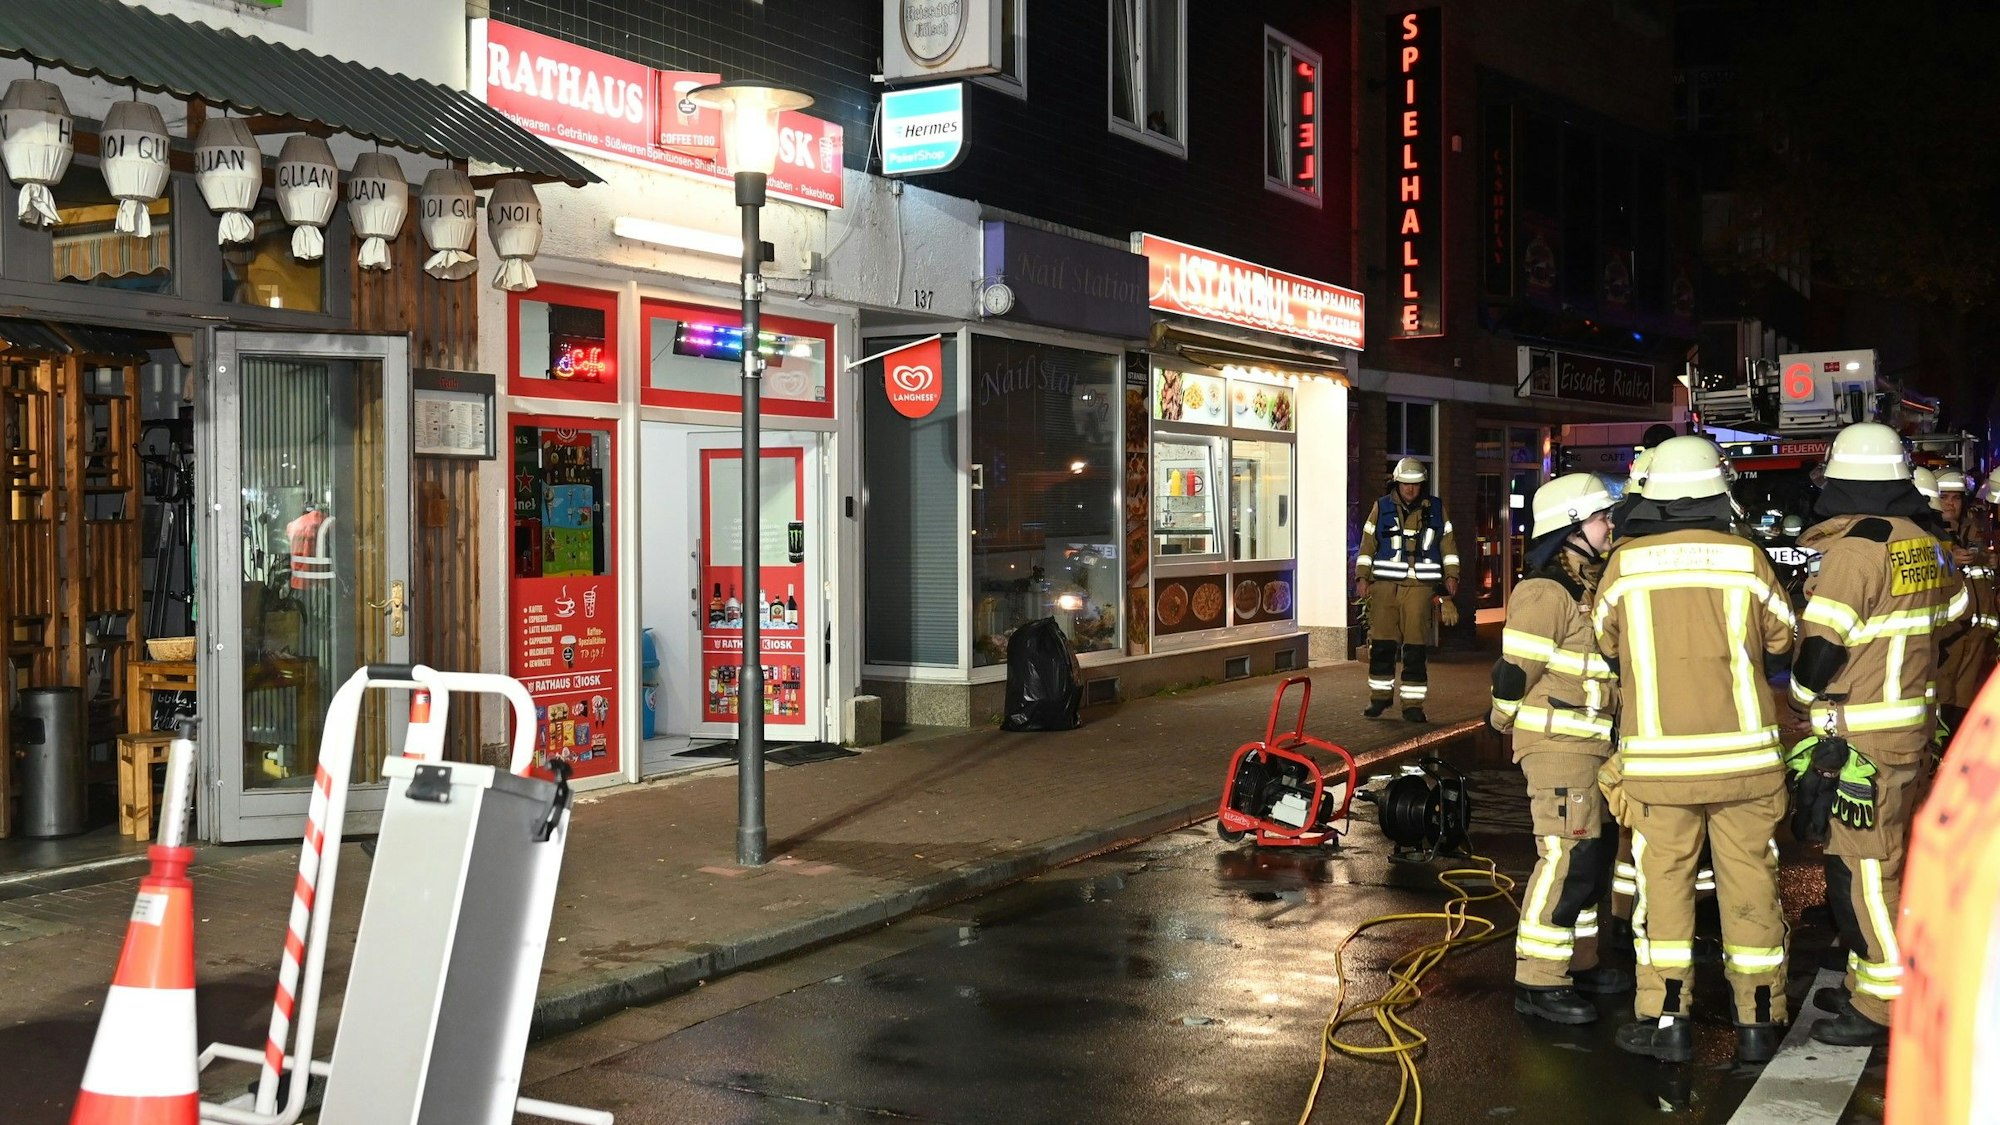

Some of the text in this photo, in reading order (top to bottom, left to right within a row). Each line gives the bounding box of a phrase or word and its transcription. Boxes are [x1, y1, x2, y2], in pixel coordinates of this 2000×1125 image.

[488, 42, 643, 123] RATHAUS
[660, 132, 692, 145] COFFEE
[905, 121, 958, 138] Hermes
[557, 124, 599, 144] Getränke
[605, 136, 647, 156] Süßwaren
[801, 184, 835, 203] Paketshop
[1401, 13, 1420, 332] SPIELHALLE
[279, 165, 334, 191] QUAN
[498, 205, 530, 224] NOI
[913, 289, 935, 310] 137
[1178, 253, 1296, 325] ISTANBUL
[981, 354, 1037, 406] Nail
[1613, 369, 1650, 400] Rialto
[1784, 363, 1815, 399] 6
[1782, 443, 1827, 454] FEUERW
[722, 639, 793, 650] RATH KIOSK
[535, 675, 601, 692] RATHAUS KIOSK
